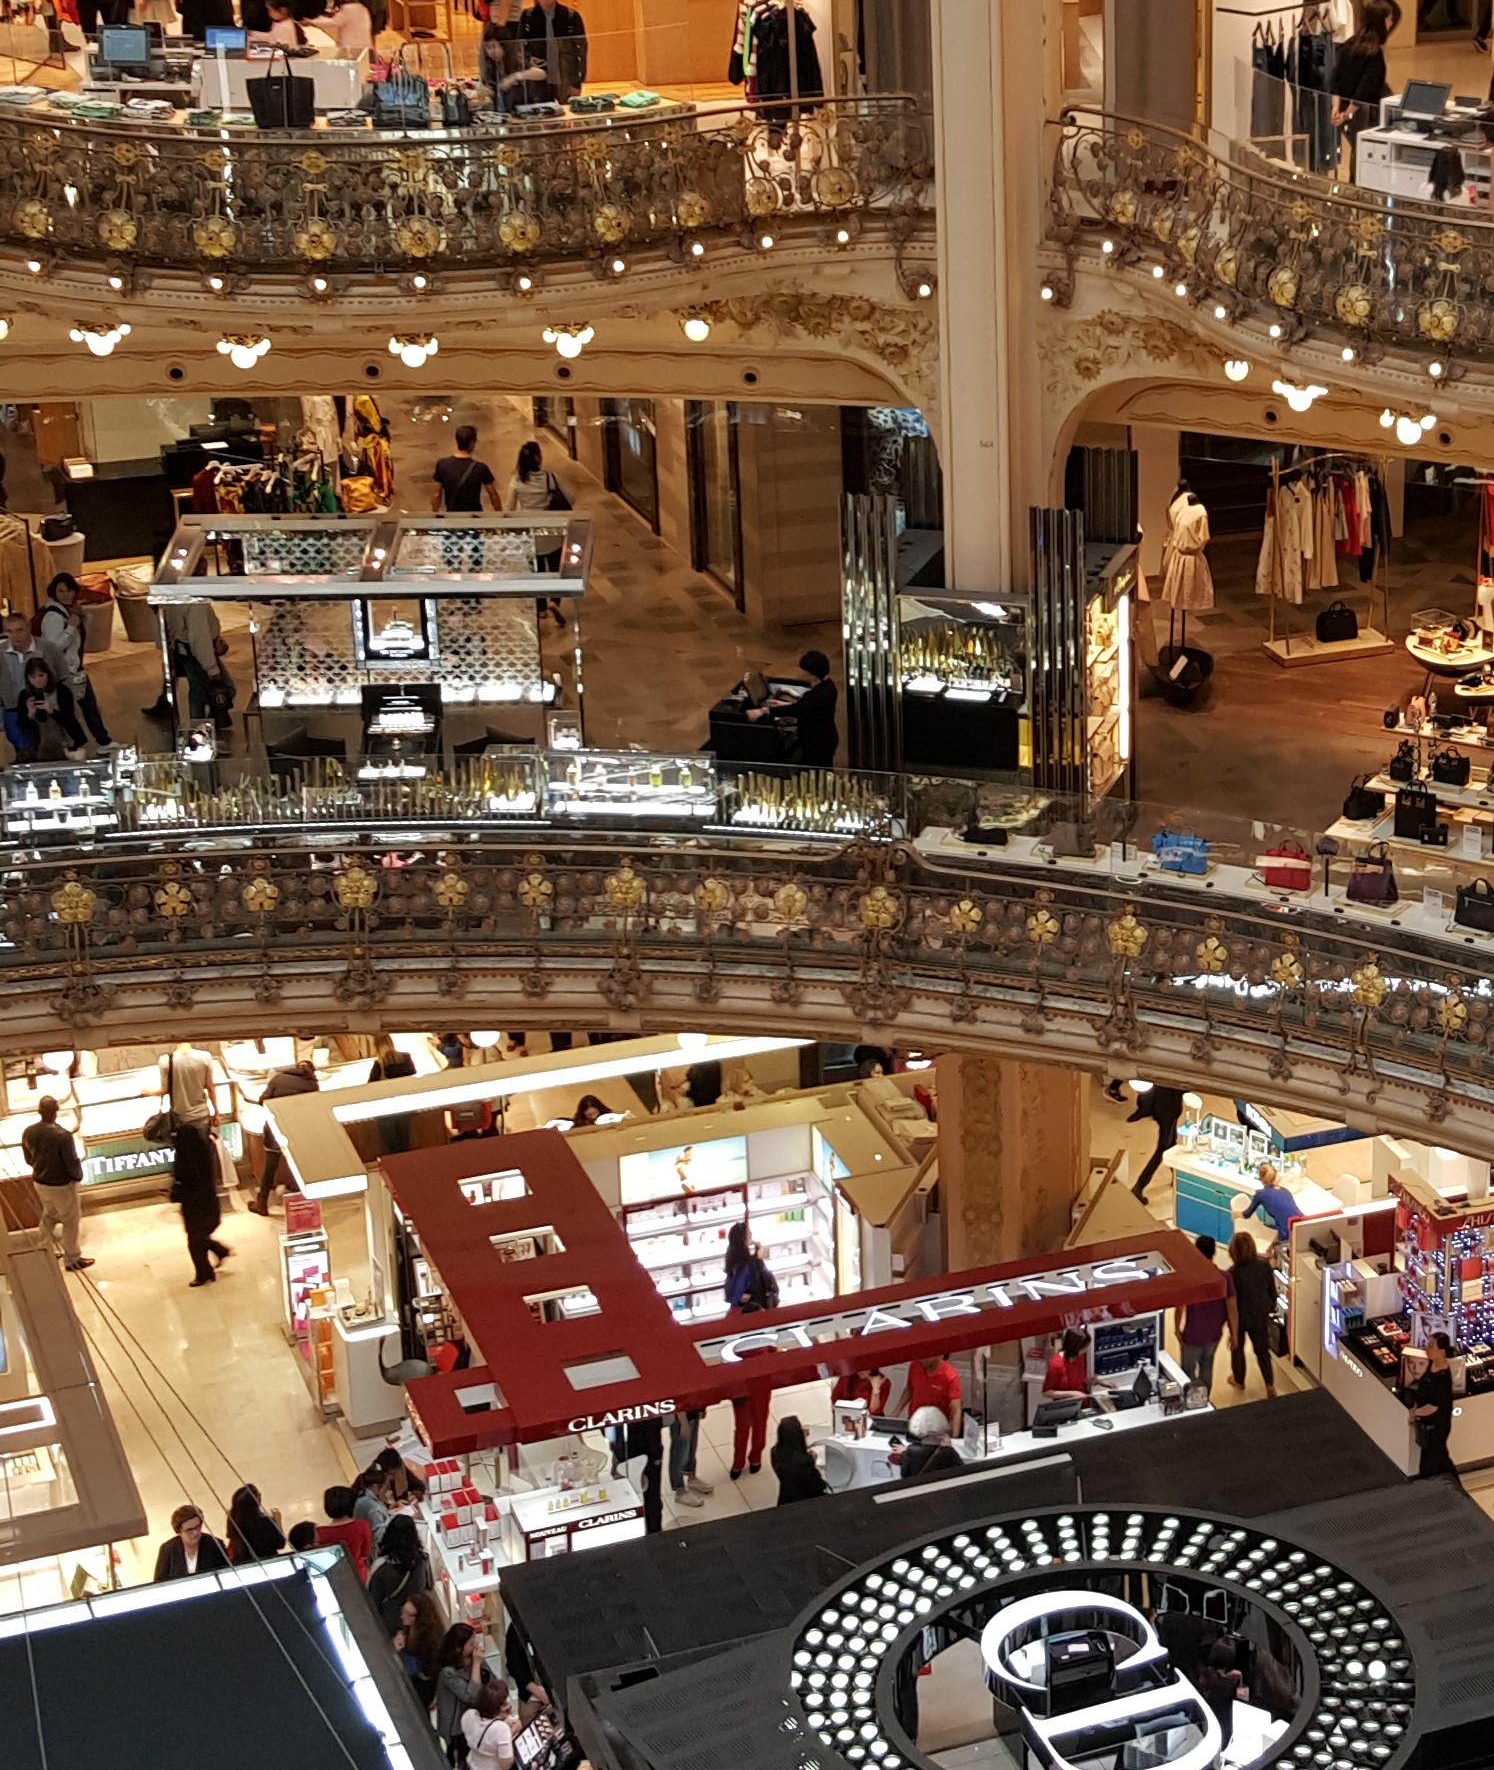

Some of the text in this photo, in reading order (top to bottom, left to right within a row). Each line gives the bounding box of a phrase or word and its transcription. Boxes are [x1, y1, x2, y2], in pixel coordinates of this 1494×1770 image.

[92, 1148, 176, 1175] TIFFANY
[567, 1399, 676, 1432] CLARINS
[578, 1509, 638, 1530] CLARINS
[529, 1525, 568, 1540] NOUVEAU
